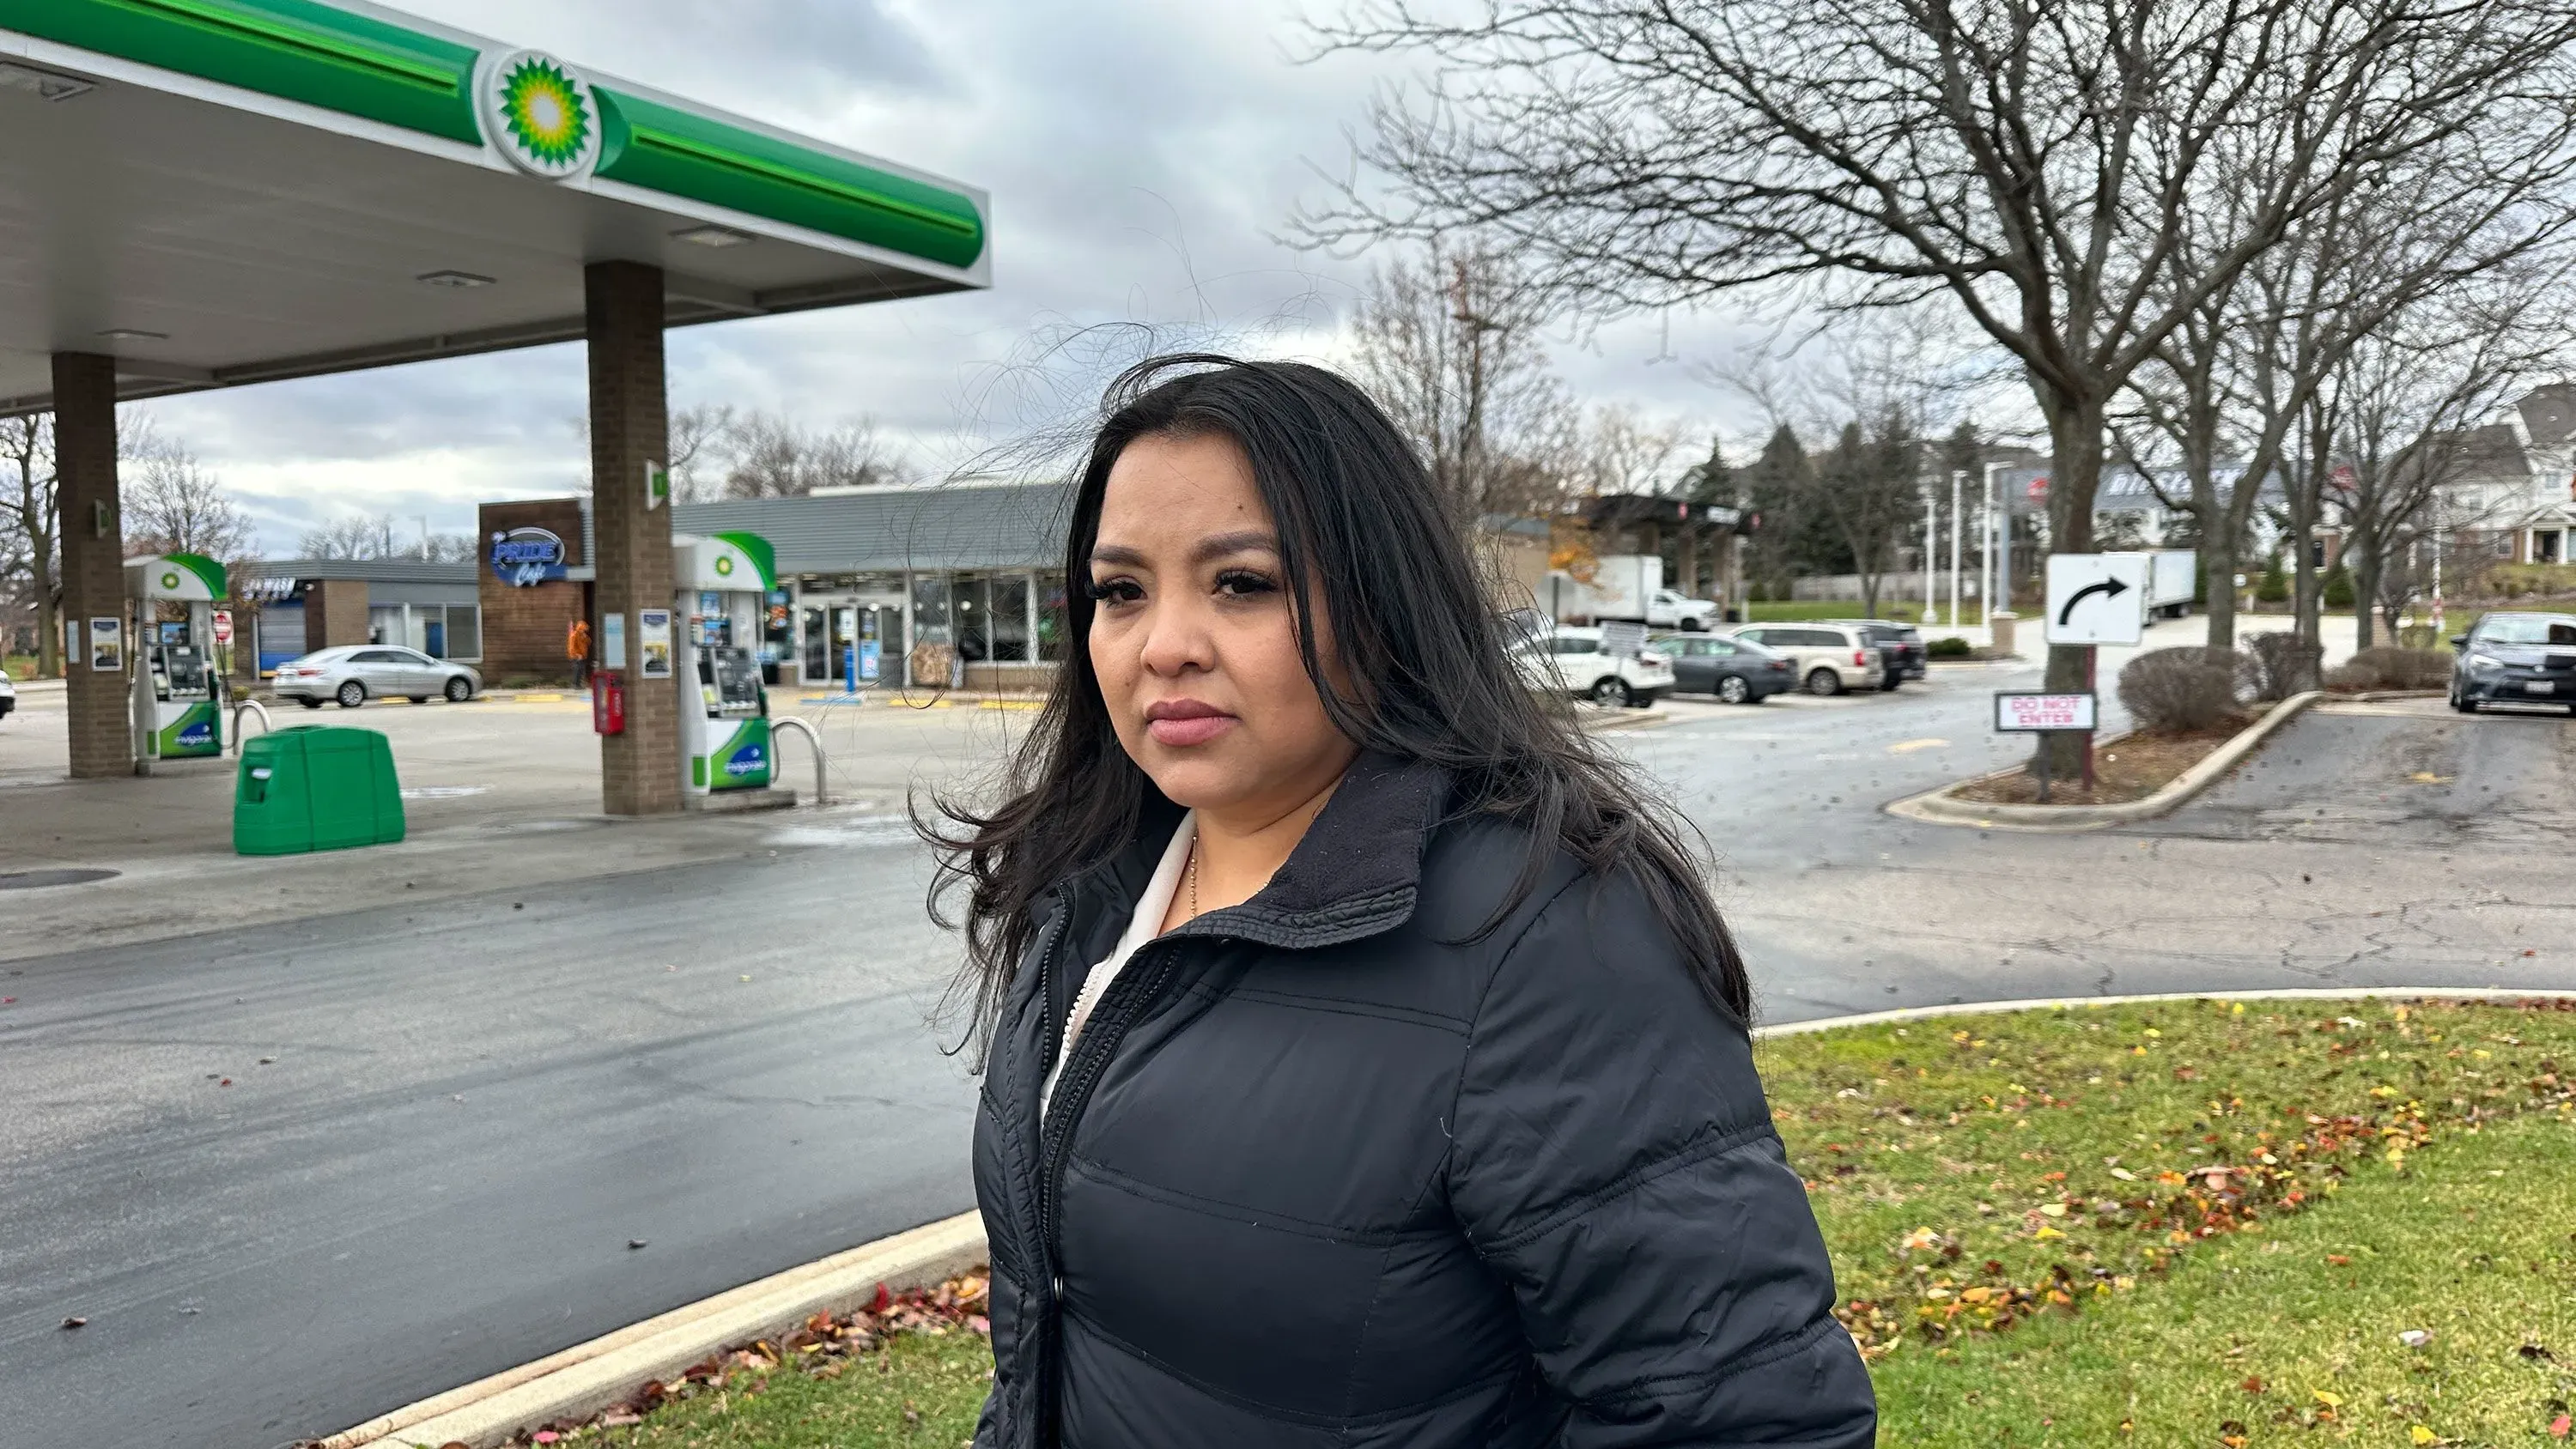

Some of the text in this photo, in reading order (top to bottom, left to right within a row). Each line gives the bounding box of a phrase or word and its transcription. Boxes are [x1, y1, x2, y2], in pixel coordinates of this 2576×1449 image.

[493, 541, 556, 563] PRIDE
[2012, 695, 2081, 712] DO NOT
[2019, 712, 2074, 725] ENTER
